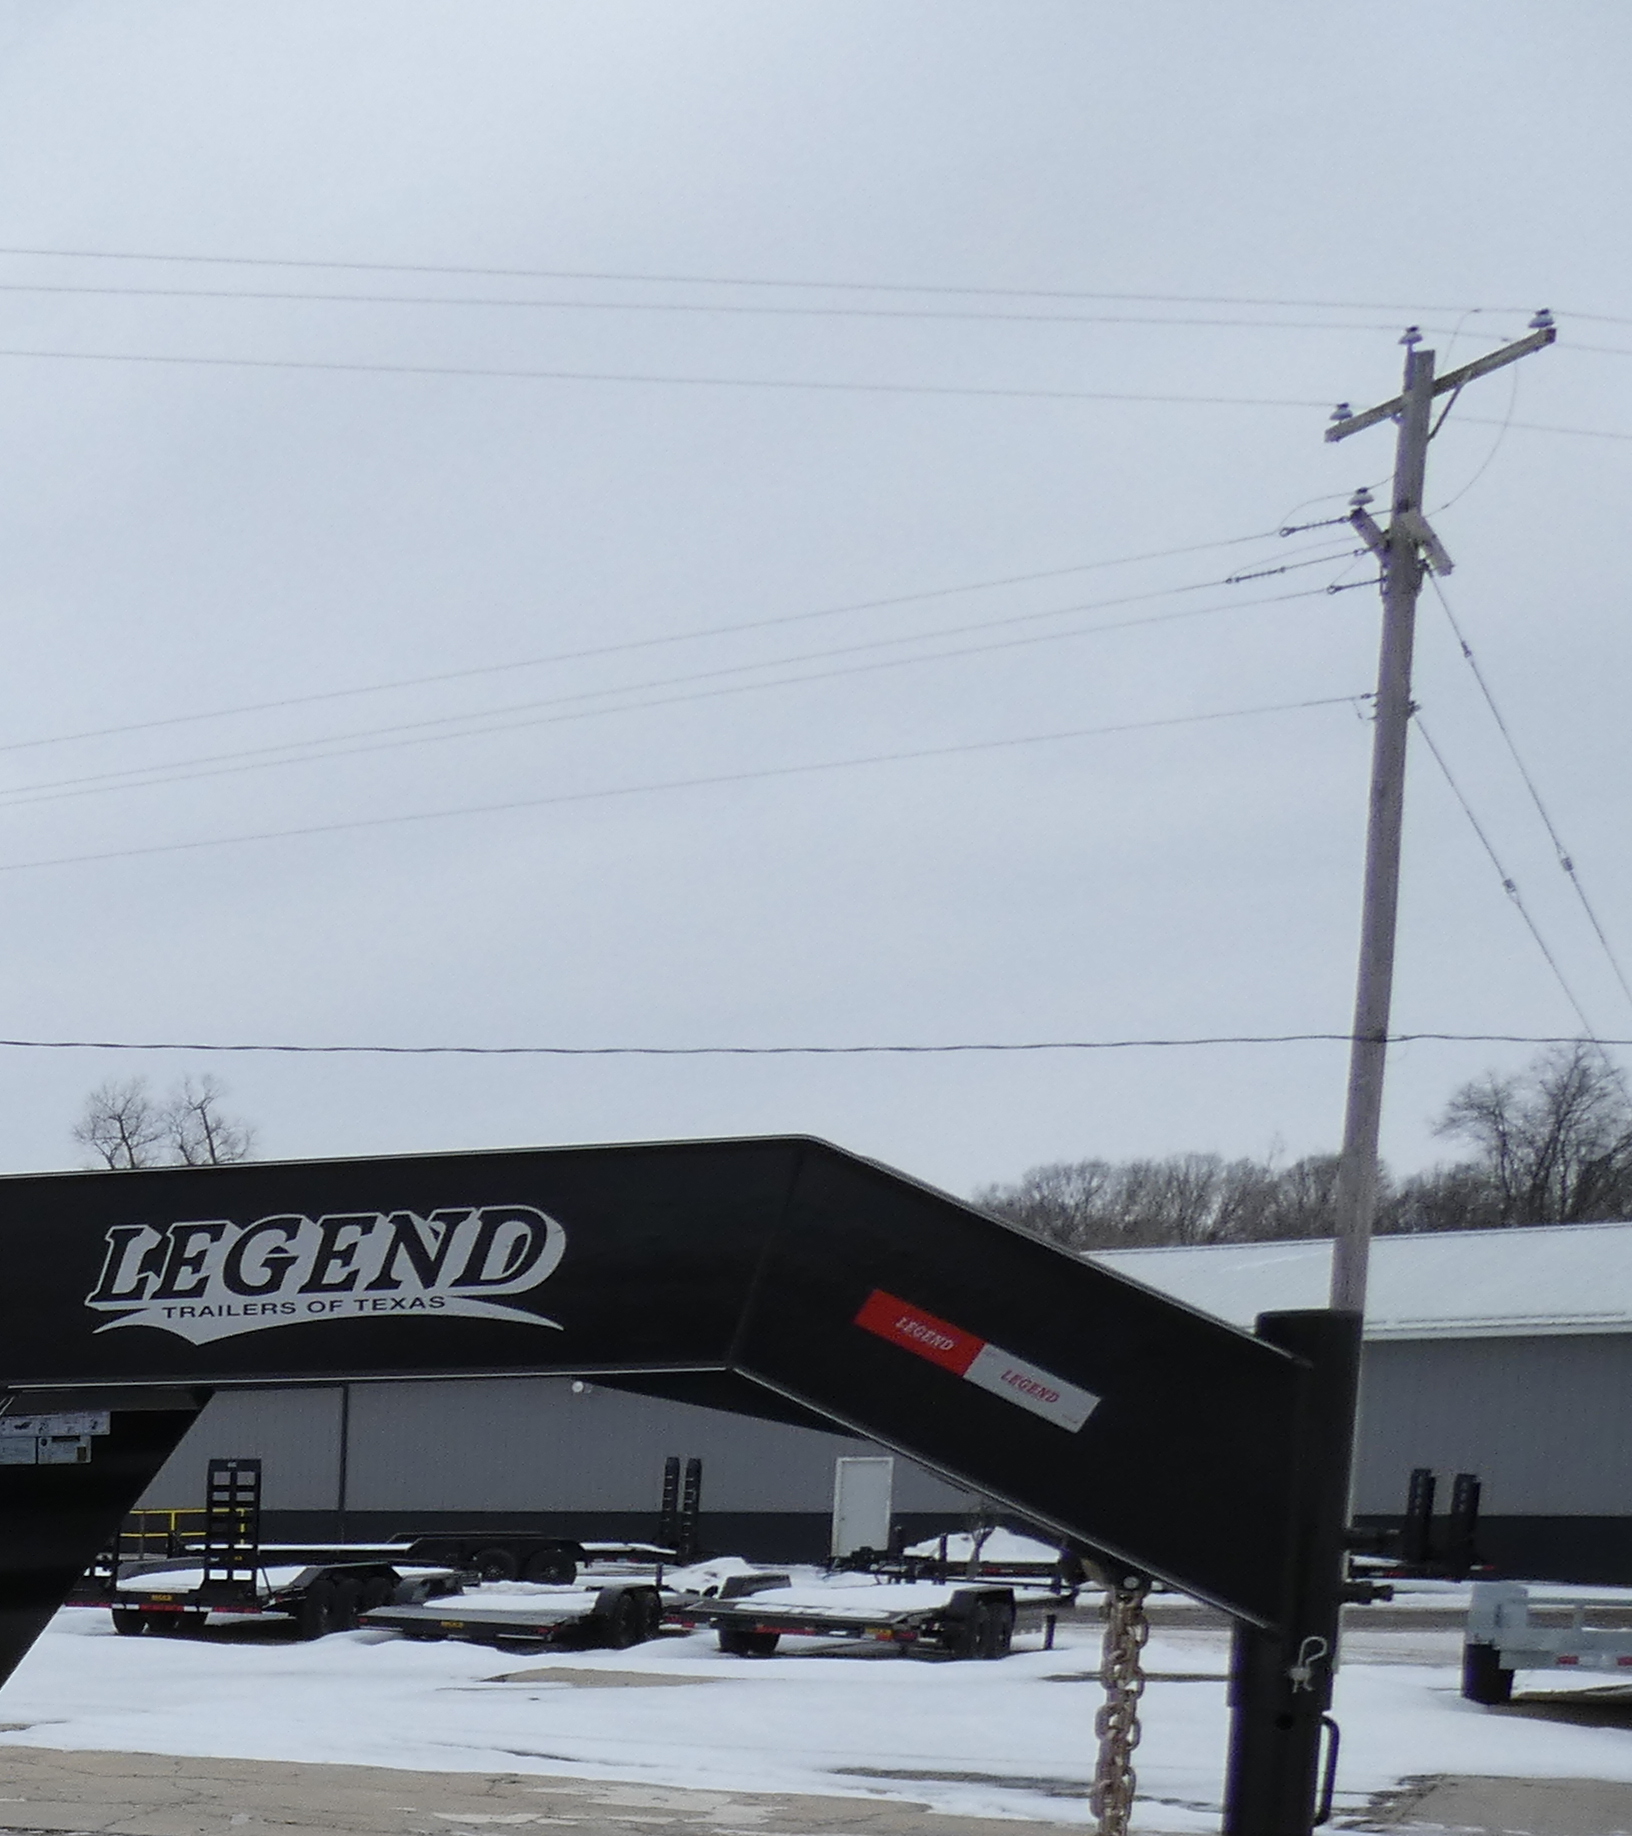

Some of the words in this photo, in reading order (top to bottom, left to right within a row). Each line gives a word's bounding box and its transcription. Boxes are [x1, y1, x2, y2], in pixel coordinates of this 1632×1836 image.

[84, 1205, 566, 1311] LEGEND
[163, 1302, 297, 1319] TRAILERS
[312, 1299, 344, 1314] OF
[354, 1295, 446, 1312] TEXAS
[895, 1317, 954, 1351] LEGEND
[1001, 1370, 1061, 1403] LEGEND
